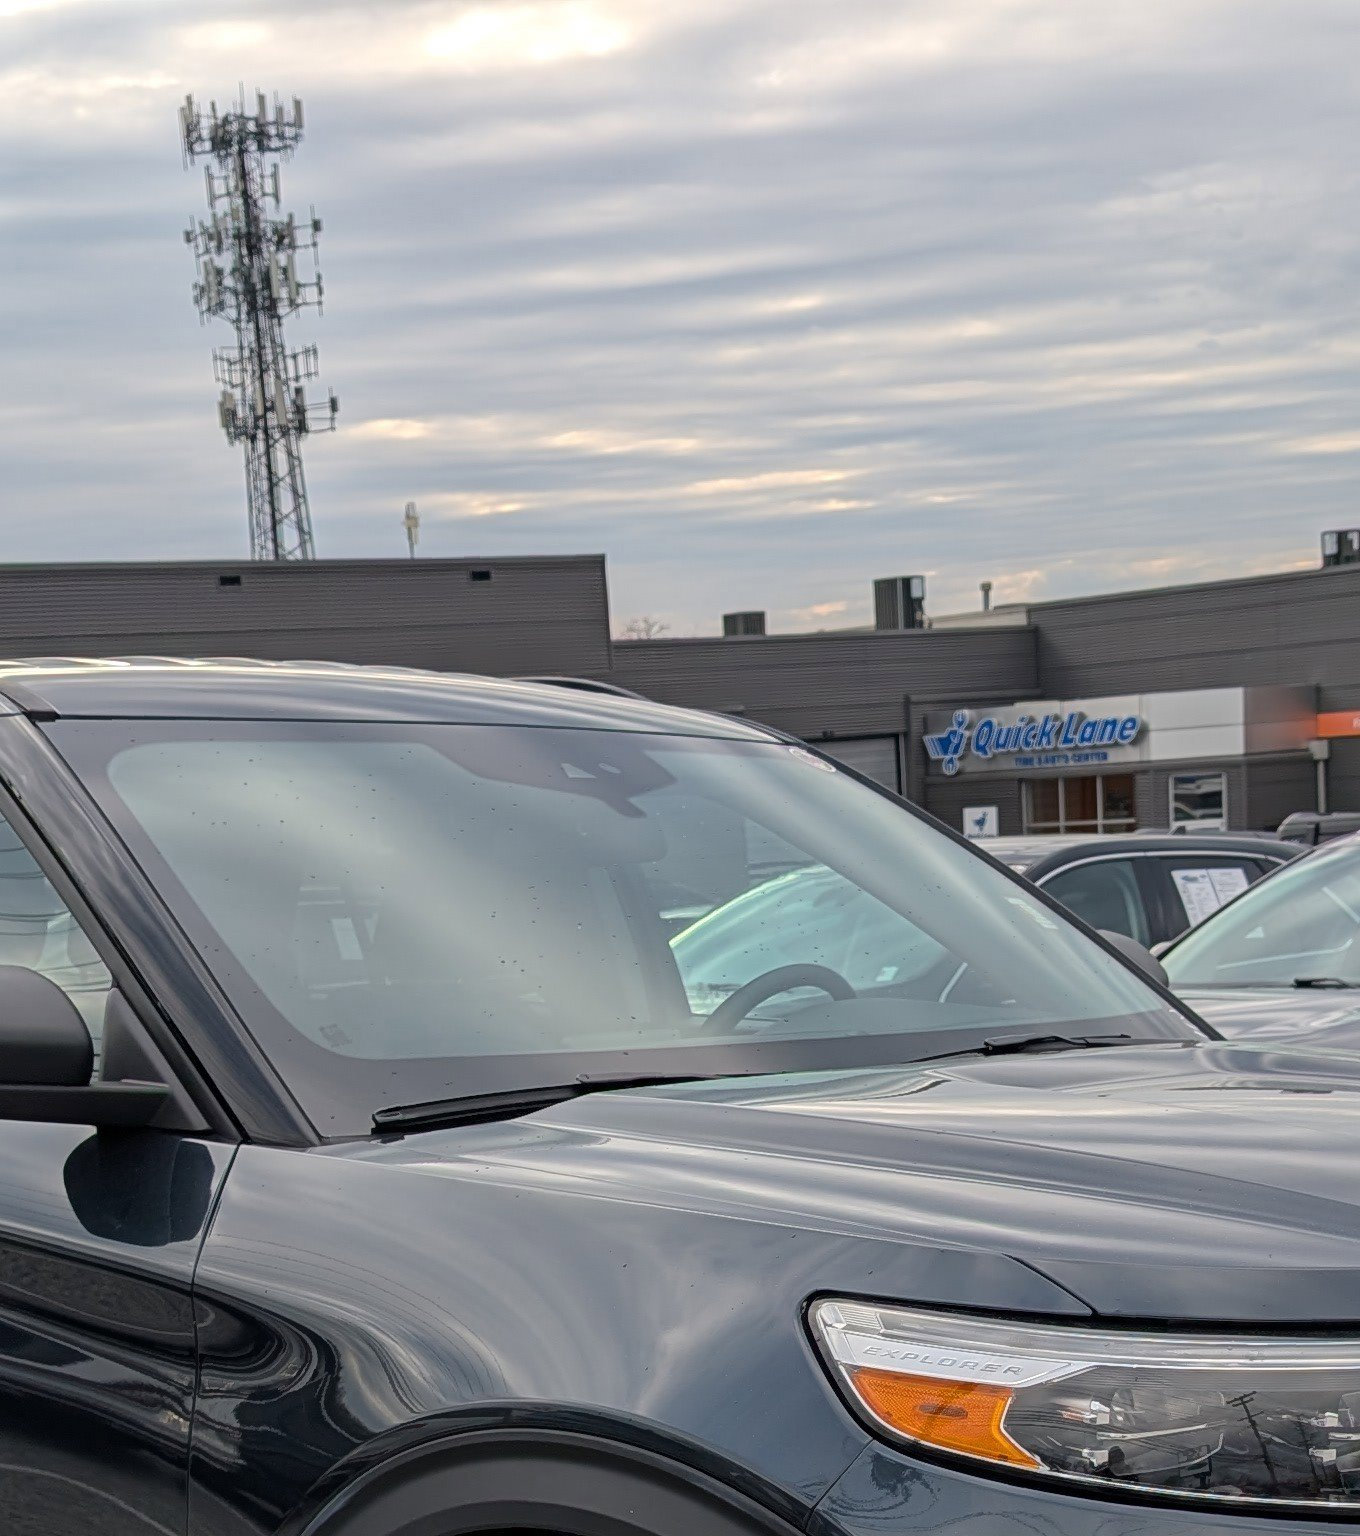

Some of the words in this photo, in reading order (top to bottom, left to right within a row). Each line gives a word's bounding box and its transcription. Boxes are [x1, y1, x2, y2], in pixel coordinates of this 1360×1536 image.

[972, 713, 1058, 758] Quick
[1058, 711, 1140, 748] Lane
[862, 1346, 1024, 1376] EXPLORER
